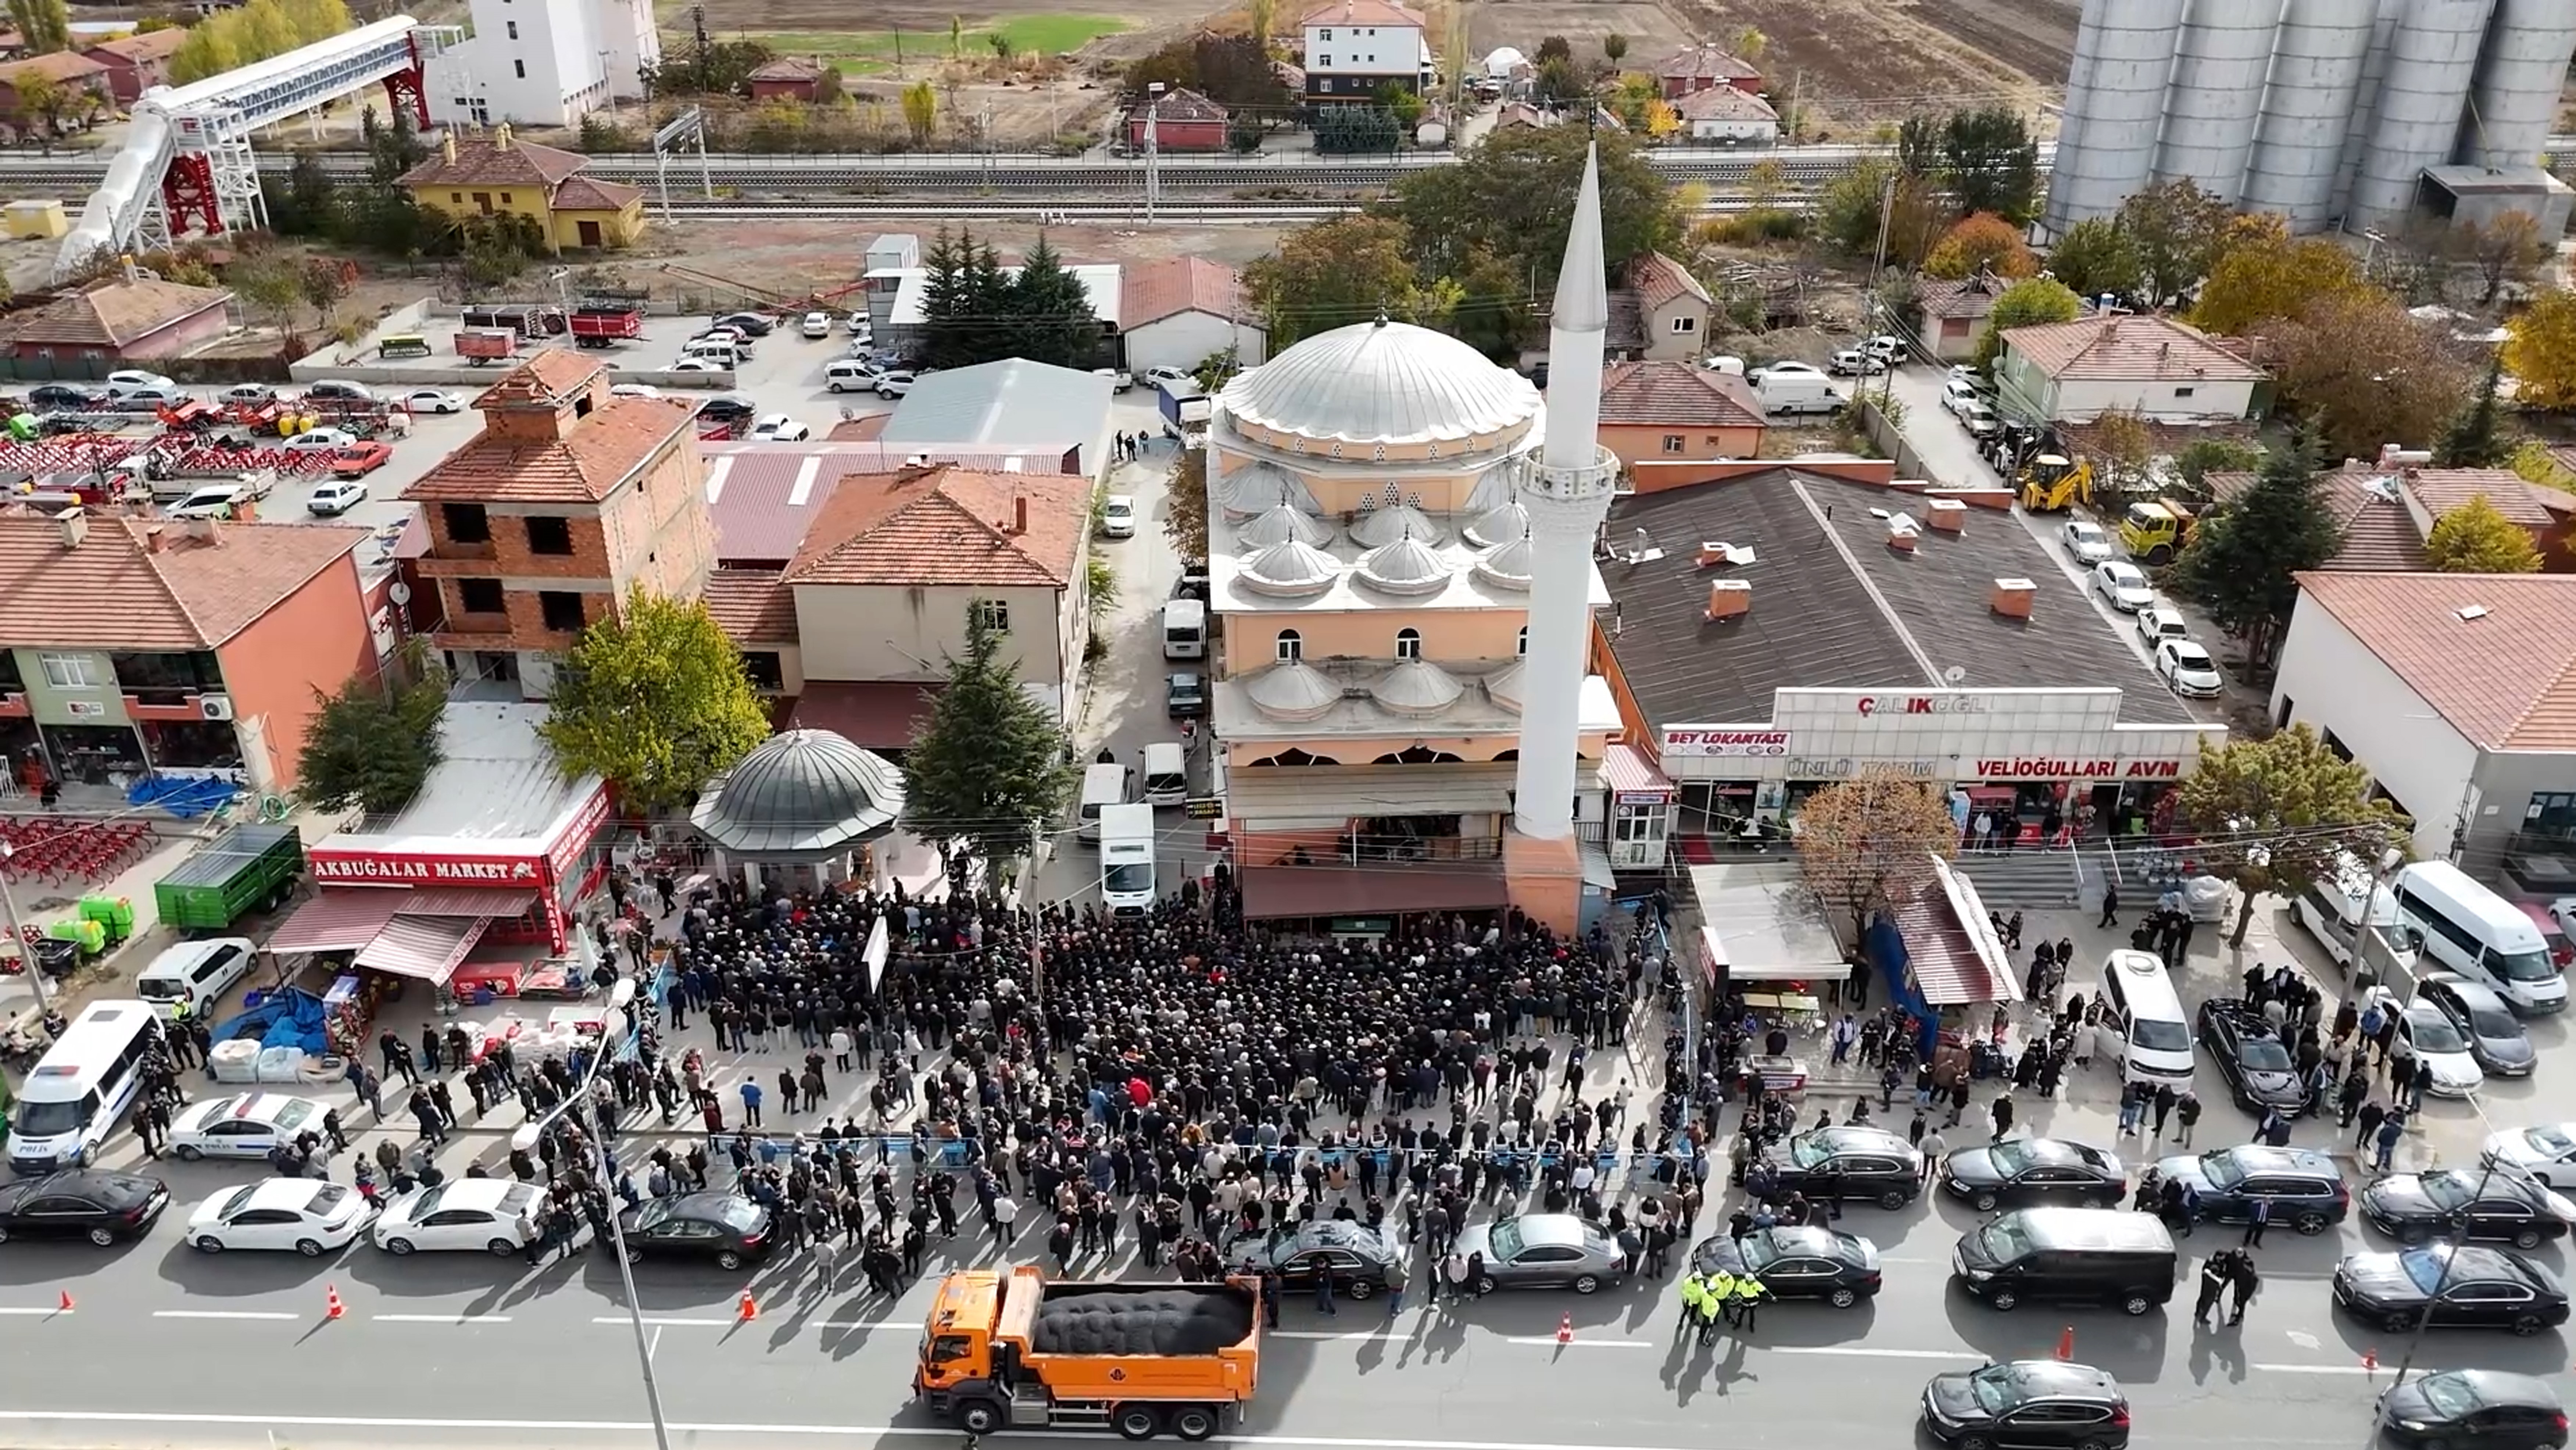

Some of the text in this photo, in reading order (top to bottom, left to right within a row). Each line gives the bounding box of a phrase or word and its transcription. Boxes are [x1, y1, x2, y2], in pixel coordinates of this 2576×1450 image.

[1668, 733, 1787, 744] BEY LOKANTASI
[1787, 757, 1853, 777] ÜNLÜ
[1977, 757, 2179, 776] VELİOĞULLARI AVM
[315, 859, 508, 879] AKBUĞALAR MARKET
[544, 899, 561, 948] KASAP
